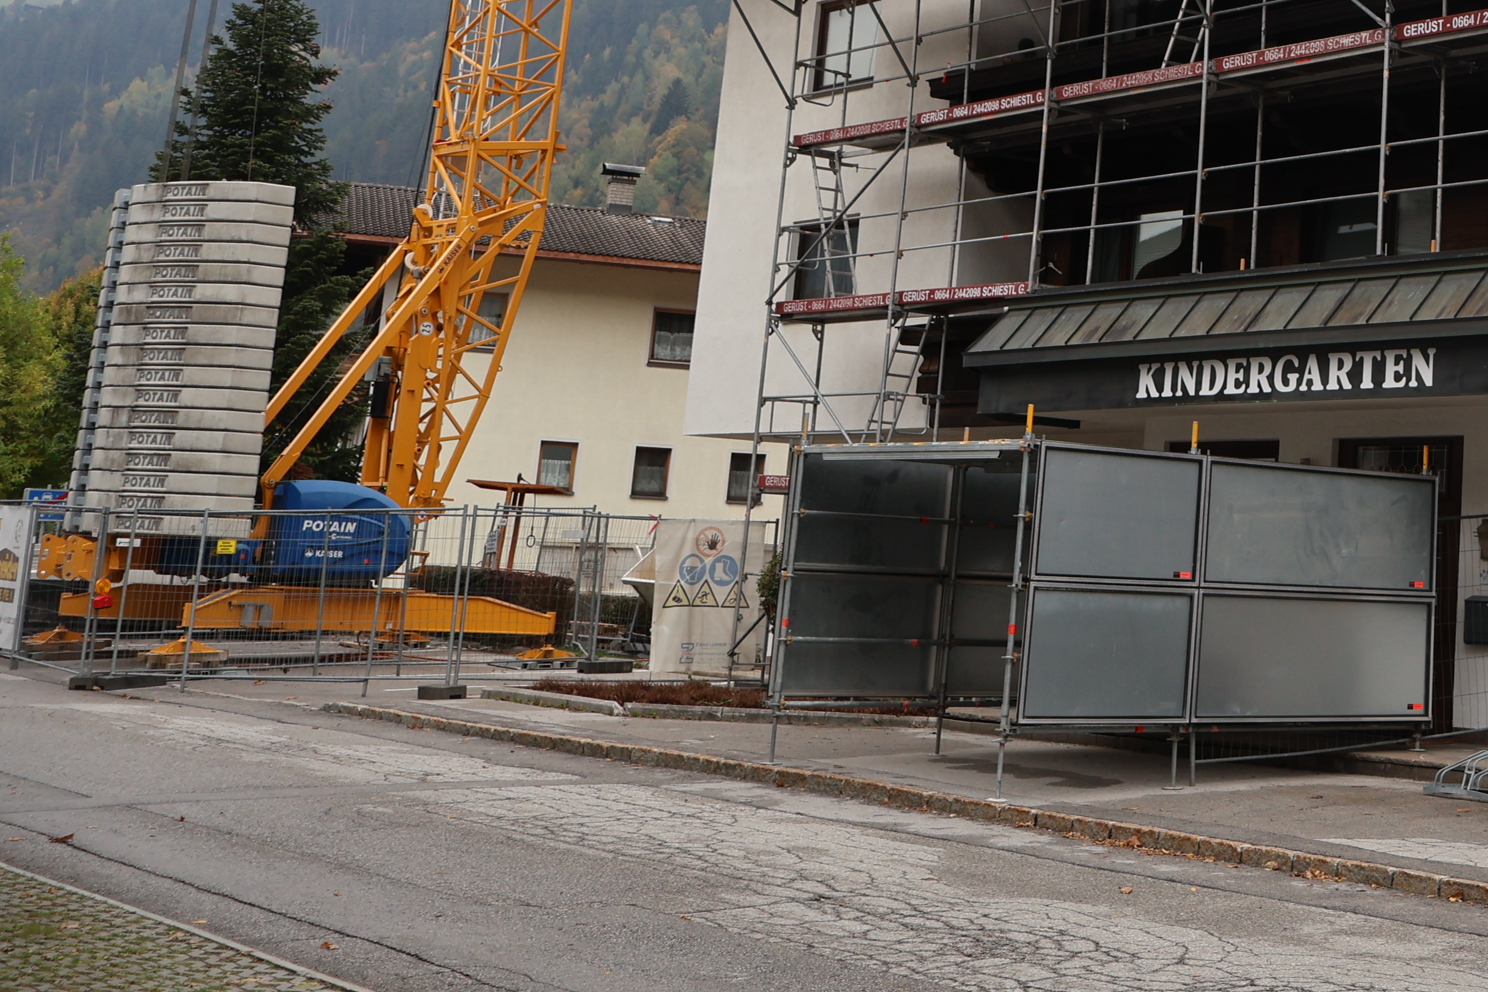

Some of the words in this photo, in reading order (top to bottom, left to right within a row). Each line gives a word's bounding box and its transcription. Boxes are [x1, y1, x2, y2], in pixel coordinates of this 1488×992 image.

[1403, 18, 1443, 37] GERÜST
[1452, 13, 1474, 28] 0664
[166, 186, 206, 197] POTAIN
[163, 206, 204, 217] POTAIN
[160, 226, 203, 237] POTAIN
[157, 247, 199, 257] POTAIN
[443, 244, 463, 269] KAISER
[154, 267, 196, 278] POTAIN
[151, 288, 192, 299] POTAIN
[148, 308, 189, 319] POTAIN
[421, 323, 432, 334] 25
[144, 329, 186, 340] POTAIN
[142, 349, 183, 361] POTAIN
[138, 370, 180, 382] POTAIN
[1136, 348, 1437, 399] KINDERGARTEN
[136, 391, 178, 402] POTAIN
[133, 412, 175, 424] POTAIN
[130, 433, 171, 445] POTAIN
[127, 455, 169, 467] POTAIN
[123, 477, 165, 488] POTAIN
[120, 497, 163, 509] POTAIN
[117, 517, 160, 531] POAIN
